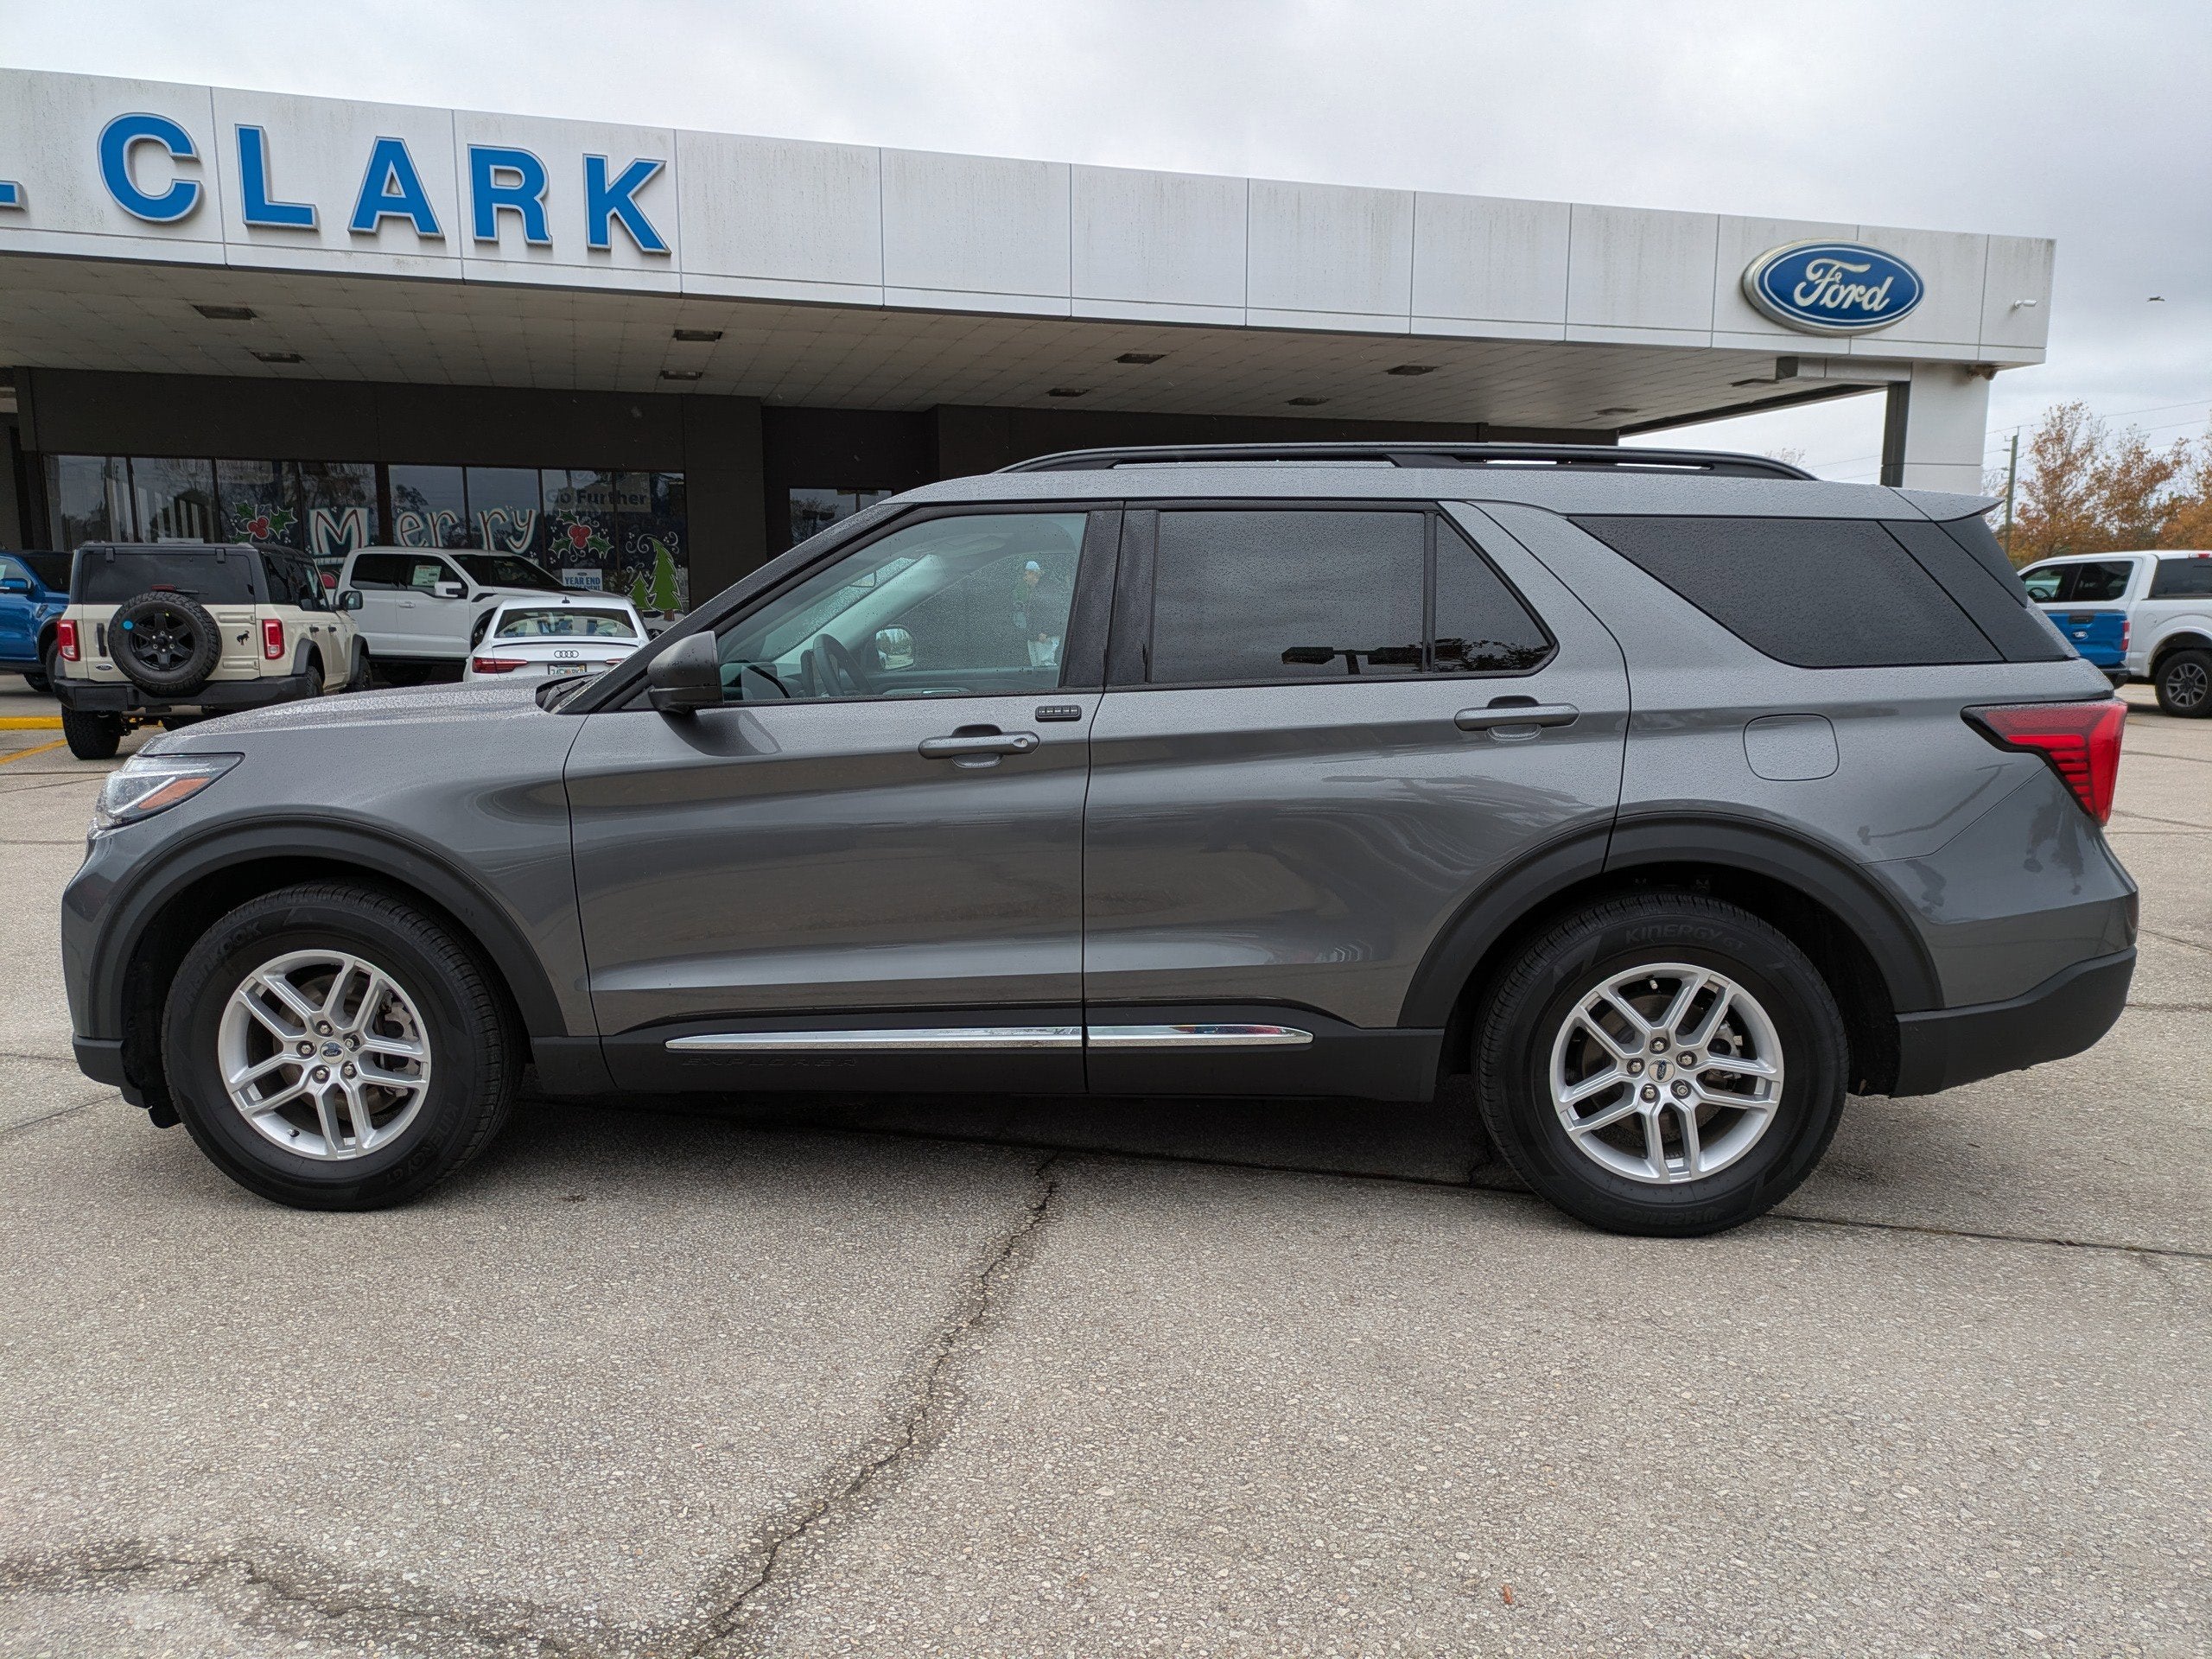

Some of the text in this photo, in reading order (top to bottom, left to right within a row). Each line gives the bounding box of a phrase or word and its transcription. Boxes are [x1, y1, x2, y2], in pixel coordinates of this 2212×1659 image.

[97, 112, 671, 254] CLARK
[1793, 257, 1894, 312] Ford
[545, 488, 647, 505] Go Further
[308, 507, 537, 556] Merry
[565, 576, 601, 585] YEAR END
[682, 1057, 858, 1067] EXPLORER
